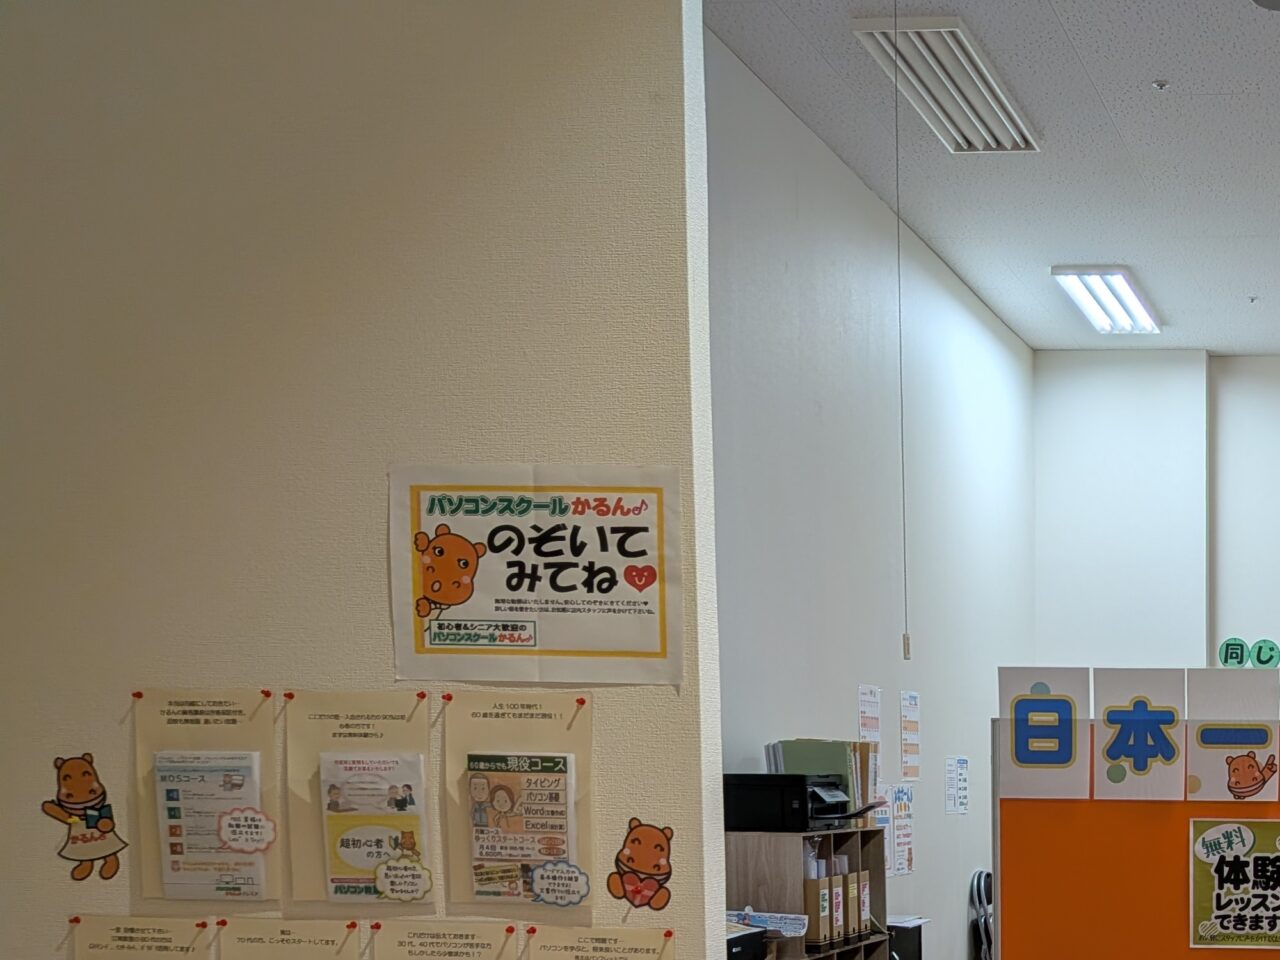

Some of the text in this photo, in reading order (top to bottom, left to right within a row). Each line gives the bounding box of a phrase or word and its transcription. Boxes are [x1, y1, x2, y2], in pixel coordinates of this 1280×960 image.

[487, 523, 649, 558] のぞいて
[505, 560, 618, 594] みてね
[526, 778, 560, 788] タイピング
[340, 838, 383, 849] 超初心者
[1202, 826, 1246, 858] 無料
